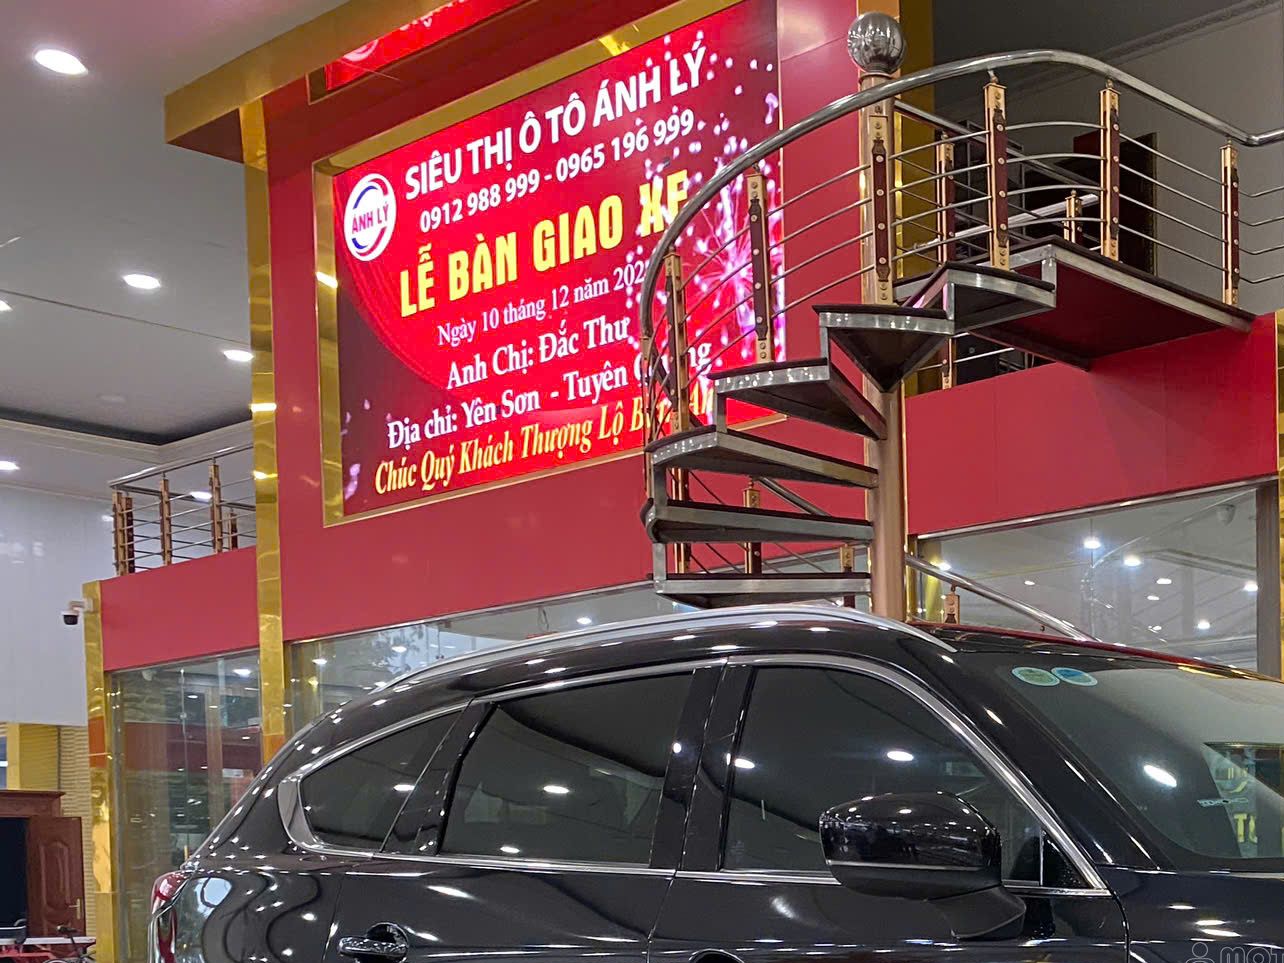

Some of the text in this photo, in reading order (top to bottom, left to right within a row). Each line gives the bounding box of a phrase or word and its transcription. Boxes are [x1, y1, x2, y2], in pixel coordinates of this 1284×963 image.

[405, 40, 706, 200] SIÊU THỊ Ô TÔ ÁNH LÝ
[420, 198, 464, 233] 0912
[467, 184, 501, 216] 988
[505, 168, 540, 202] 999
[556, 143, 605, 182] 0965
[611, 125, 649, 161] 196
[653, 108, 694, 146] 999
[400, 243, 435, 317] LỄ
[448, 233, 518, 301] BÀN
[533, 195, 624, 272] GIAO
[438, 259, 649, 348] Ngày 10 tháng 12 năm 202
[446, 315, 631, 390] Anh Chị: Đắc Thư
[375, 456, 417, 494] Chúc
[420, 444, 455, 491] Quý
[458, 430, 514, 474] Khách
[520, 419, 594, 460] Thượng
[597, 399, 625, 446] Lộ
[387, 416, 421, 450] Địa
[461, 396, 497, 429] Yên
[501, 388, 542, 419] Sơn
[562, 359, 629, 405] Tuyên
